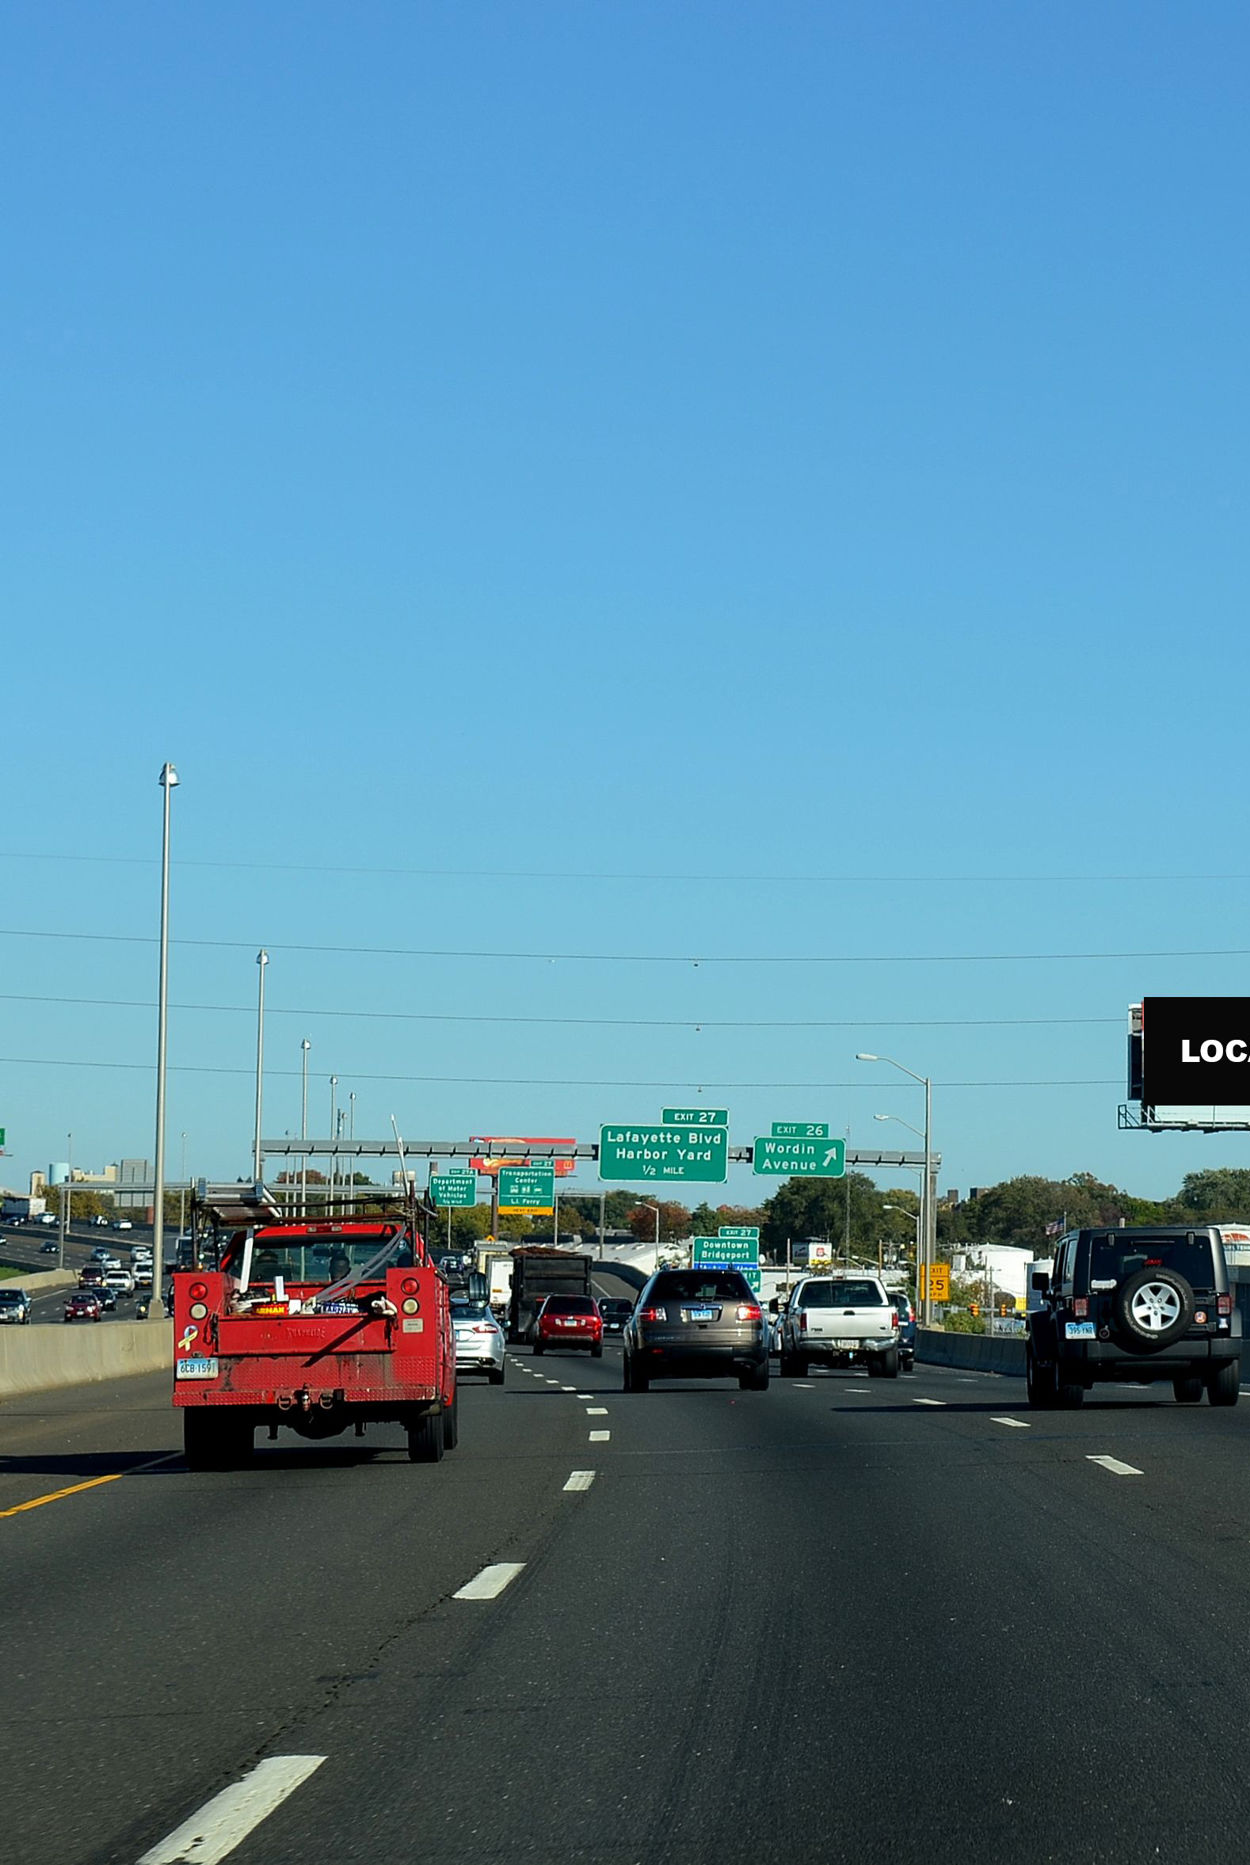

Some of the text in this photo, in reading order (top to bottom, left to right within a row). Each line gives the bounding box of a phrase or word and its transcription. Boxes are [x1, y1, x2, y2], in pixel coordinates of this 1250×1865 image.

[674, 1112, 716, 1122] EXIT 27
[776, 1125, 824, 1136] EXIT 26
[607, 1131, 721, 1145] Lafayette Blvd
[765, 1142, 815, 1154] Wordin
[616, 1148, 711, 1160] Harbor Yard
[762, 1158, 817, 1170] Avenue
[502, 1170, 552, 1179] Transportation
[663, 1167, 684, 1175] MILE
[433, 1178, 472, 1187] Department
[703, 1241, 749, 1249] Downtown
[701, 1250, 750, 1260] Bridgeport
